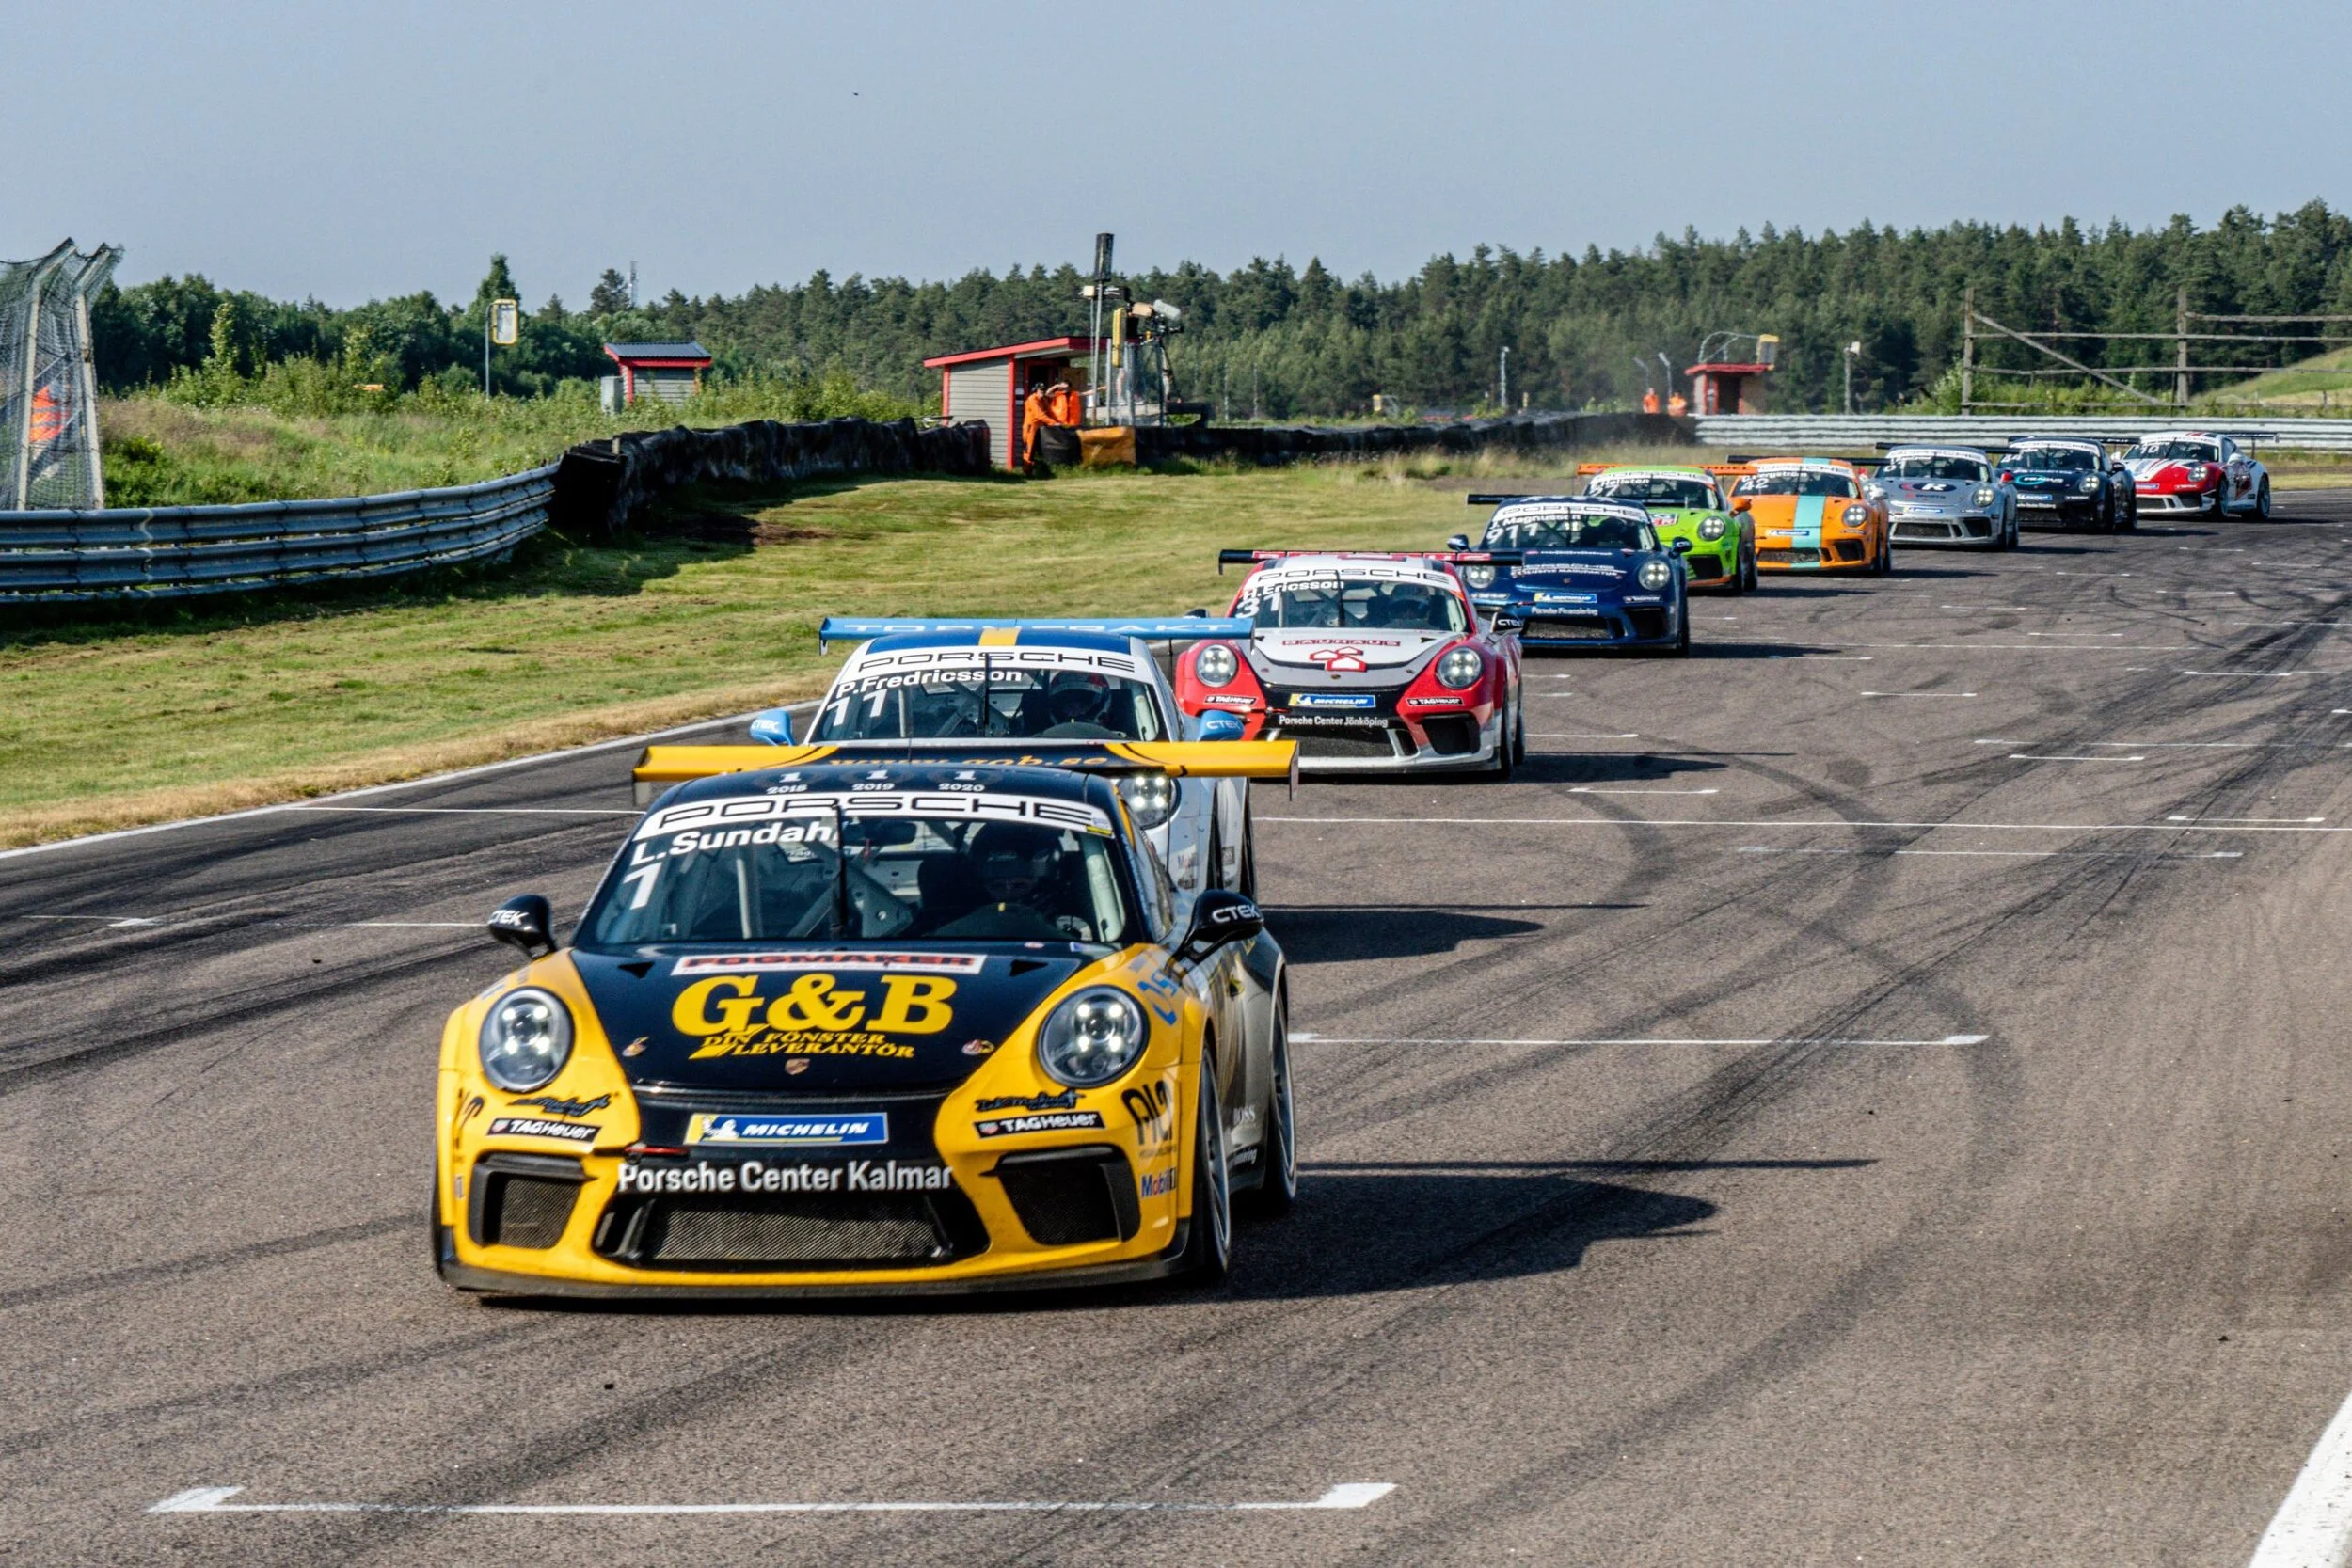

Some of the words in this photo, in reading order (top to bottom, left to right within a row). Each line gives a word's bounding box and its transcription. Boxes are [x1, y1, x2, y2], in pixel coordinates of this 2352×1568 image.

[1740, 478, 1770, 491] 42
[1486, 522, 1540, 546] 911
[1258, 567, 1450, 584] PORSCHE
[1242, 580, 1345, 602] H.Ericsson
[1234, 592, 1281, 619] 31
[858, 651, 1135, 673] PORSCHE
[835, 668, 1023, 699] P.Fredricsson
[825, 688, 888, 728] 11
[1279, 716, 1313, 726] Porsche
[1314, 716, 1343, 726] Center
[1344, 716, 1389, 728] Jönköping
[779, 771, 801, 784] 1
[866, 769, 889, 781] 1
[955, 769, 977, 781] 1
[851, 782, 895, 791] 2019
[938, 782, 986, 792] 2020
[659, 796, 1093, 830] PORSCHE
[622, 861, 663, 911] 1
[1211, 903, 1262, 924] CTEK
[683, 953, 975, 968] FOGMAKER
[672, 973, 958, 1036] G&B
[700, 1033, 756, 1047] DIN
[763, 1030, 887, 1045] FÖNSTER
[730, 1041, 915, 1059] LEVERANTÖR
[741, 1121, 871, 1137] MICHELIN
[618, 1162, 735, 1192] Porsche
[740, 1161, 842, 1192] Center
[849, 1159, 954, 1192] Kalmar
